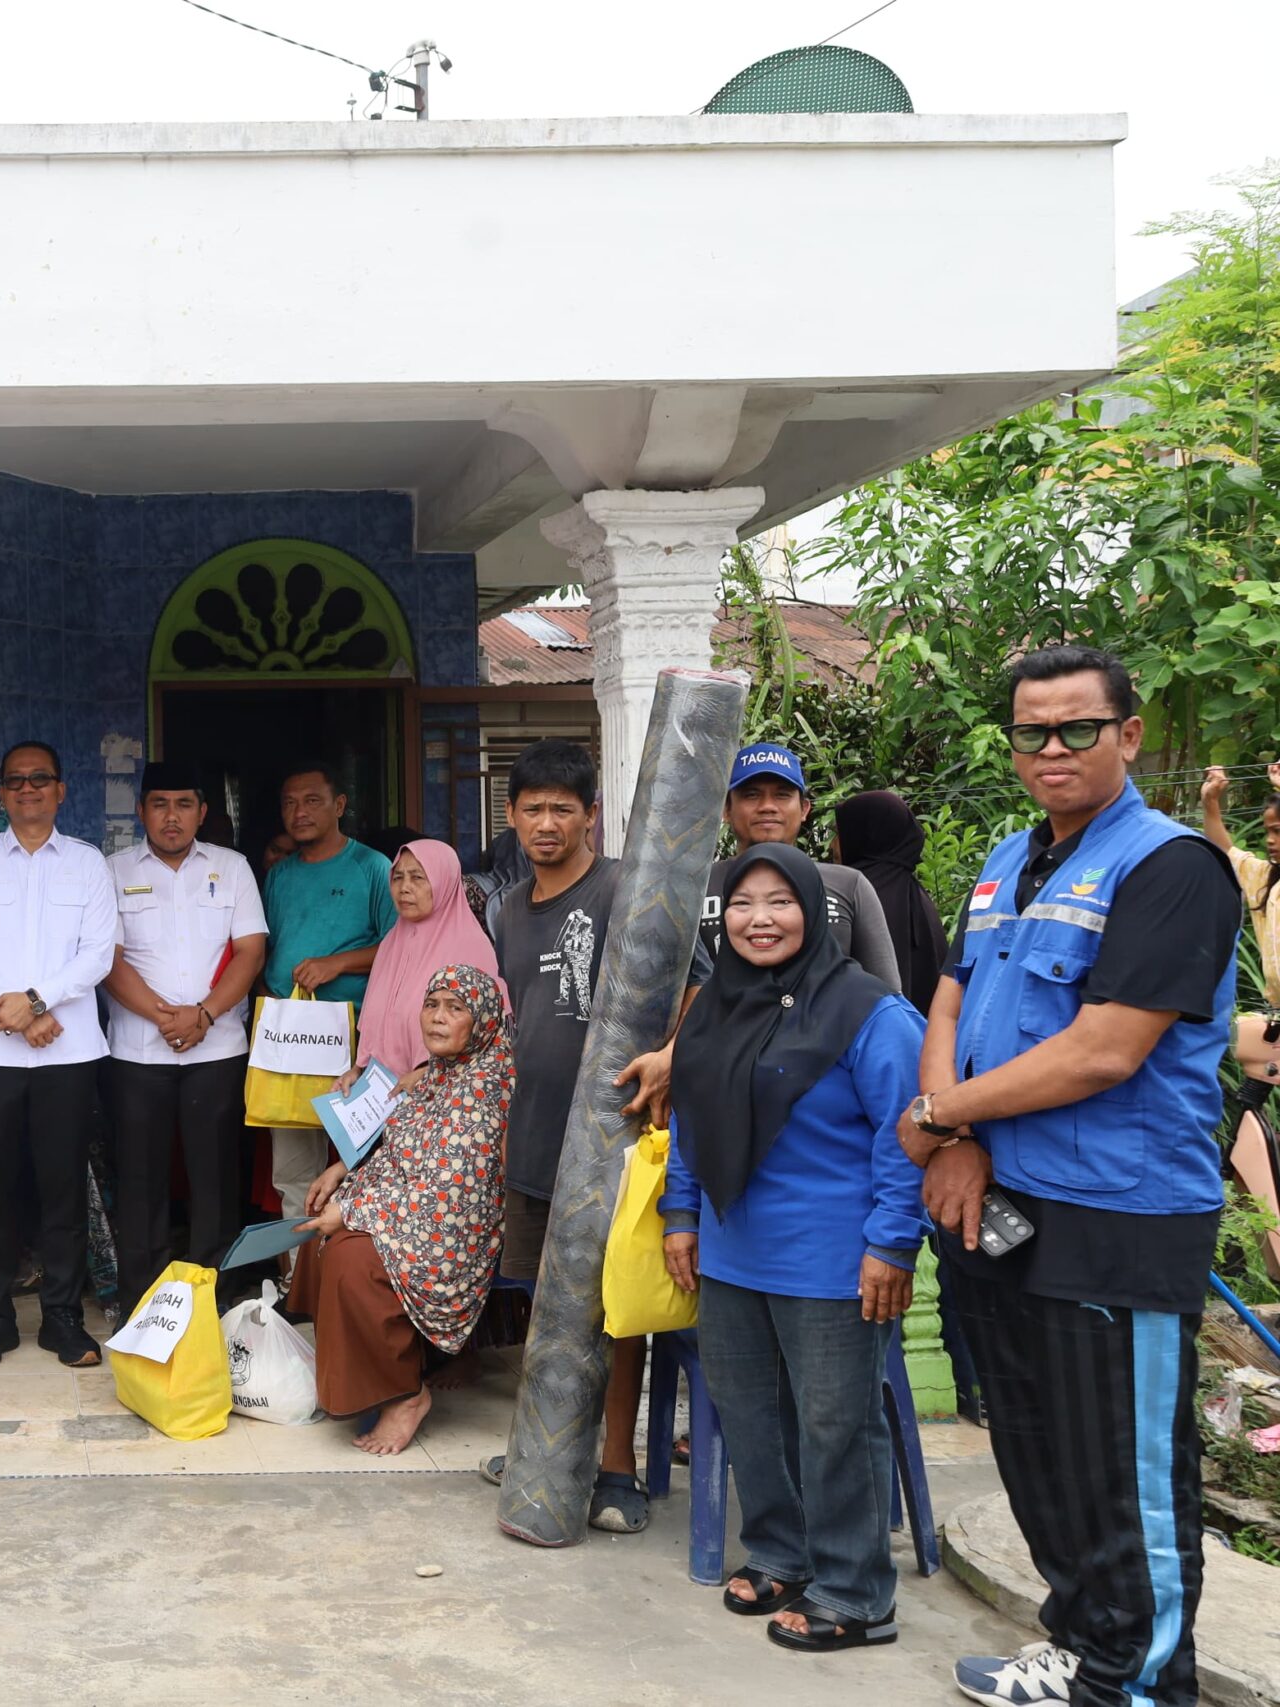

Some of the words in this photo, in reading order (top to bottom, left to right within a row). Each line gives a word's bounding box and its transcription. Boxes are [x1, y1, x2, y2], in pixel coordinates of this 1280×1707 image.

[740, 751, 792, 769] TAGANA
[539, 951, 562, 962] KNOCK
[539, 963, 562, 973] KNOCK
[263, 1028, 344, 1047] ZULKARNAEN
[231, 1394, 270, 1409] UNGBALAI
